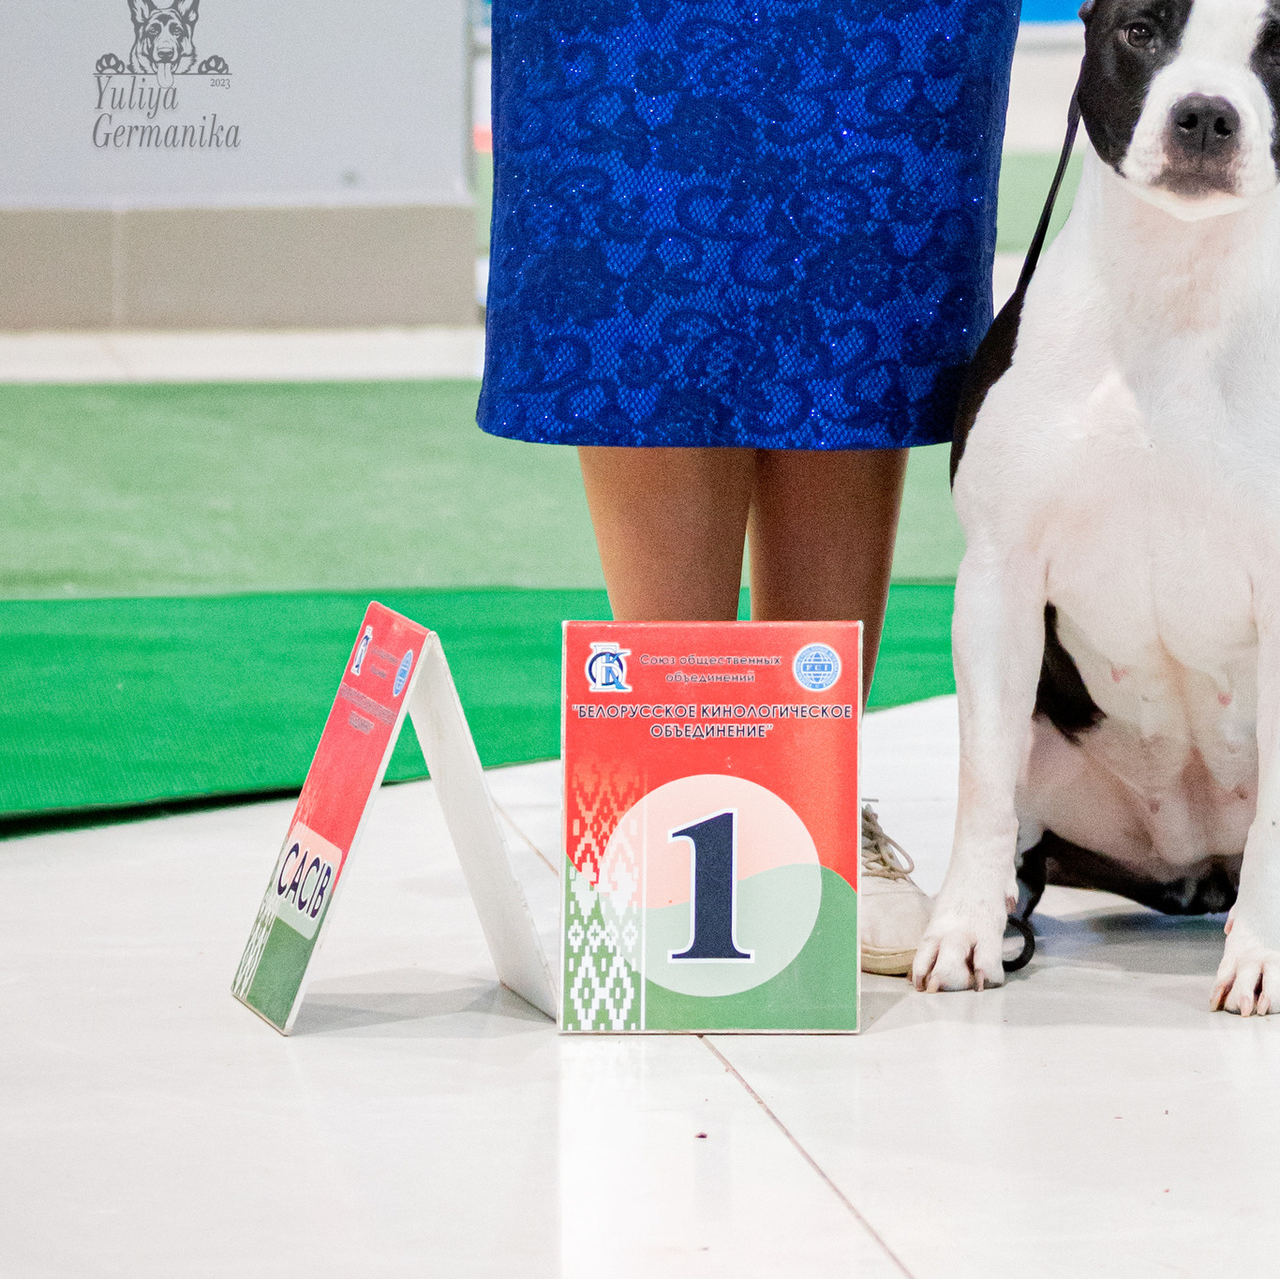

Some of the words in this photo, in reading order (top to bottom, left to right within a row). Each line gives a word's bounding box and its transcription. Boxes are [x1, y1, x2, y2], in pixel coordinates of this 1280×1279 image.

[640, 654, 675, 665] Союз
[679, 652, 782, 667] общественных
[805, 663, 829, 671] FCI
[665, 670, 756, 684] объединений
[572, 704, 697, 719] "БЕЛОРУССКОЕ
[701, 704, 852, 719] КИНОЛОГИЧЕСКОЕ
[650, 724, 773, 739] ОБЪЕДИНЕНИЕ"
[277, 842, 332, 919] CACIB
[670, 810, 753, 961] 1
